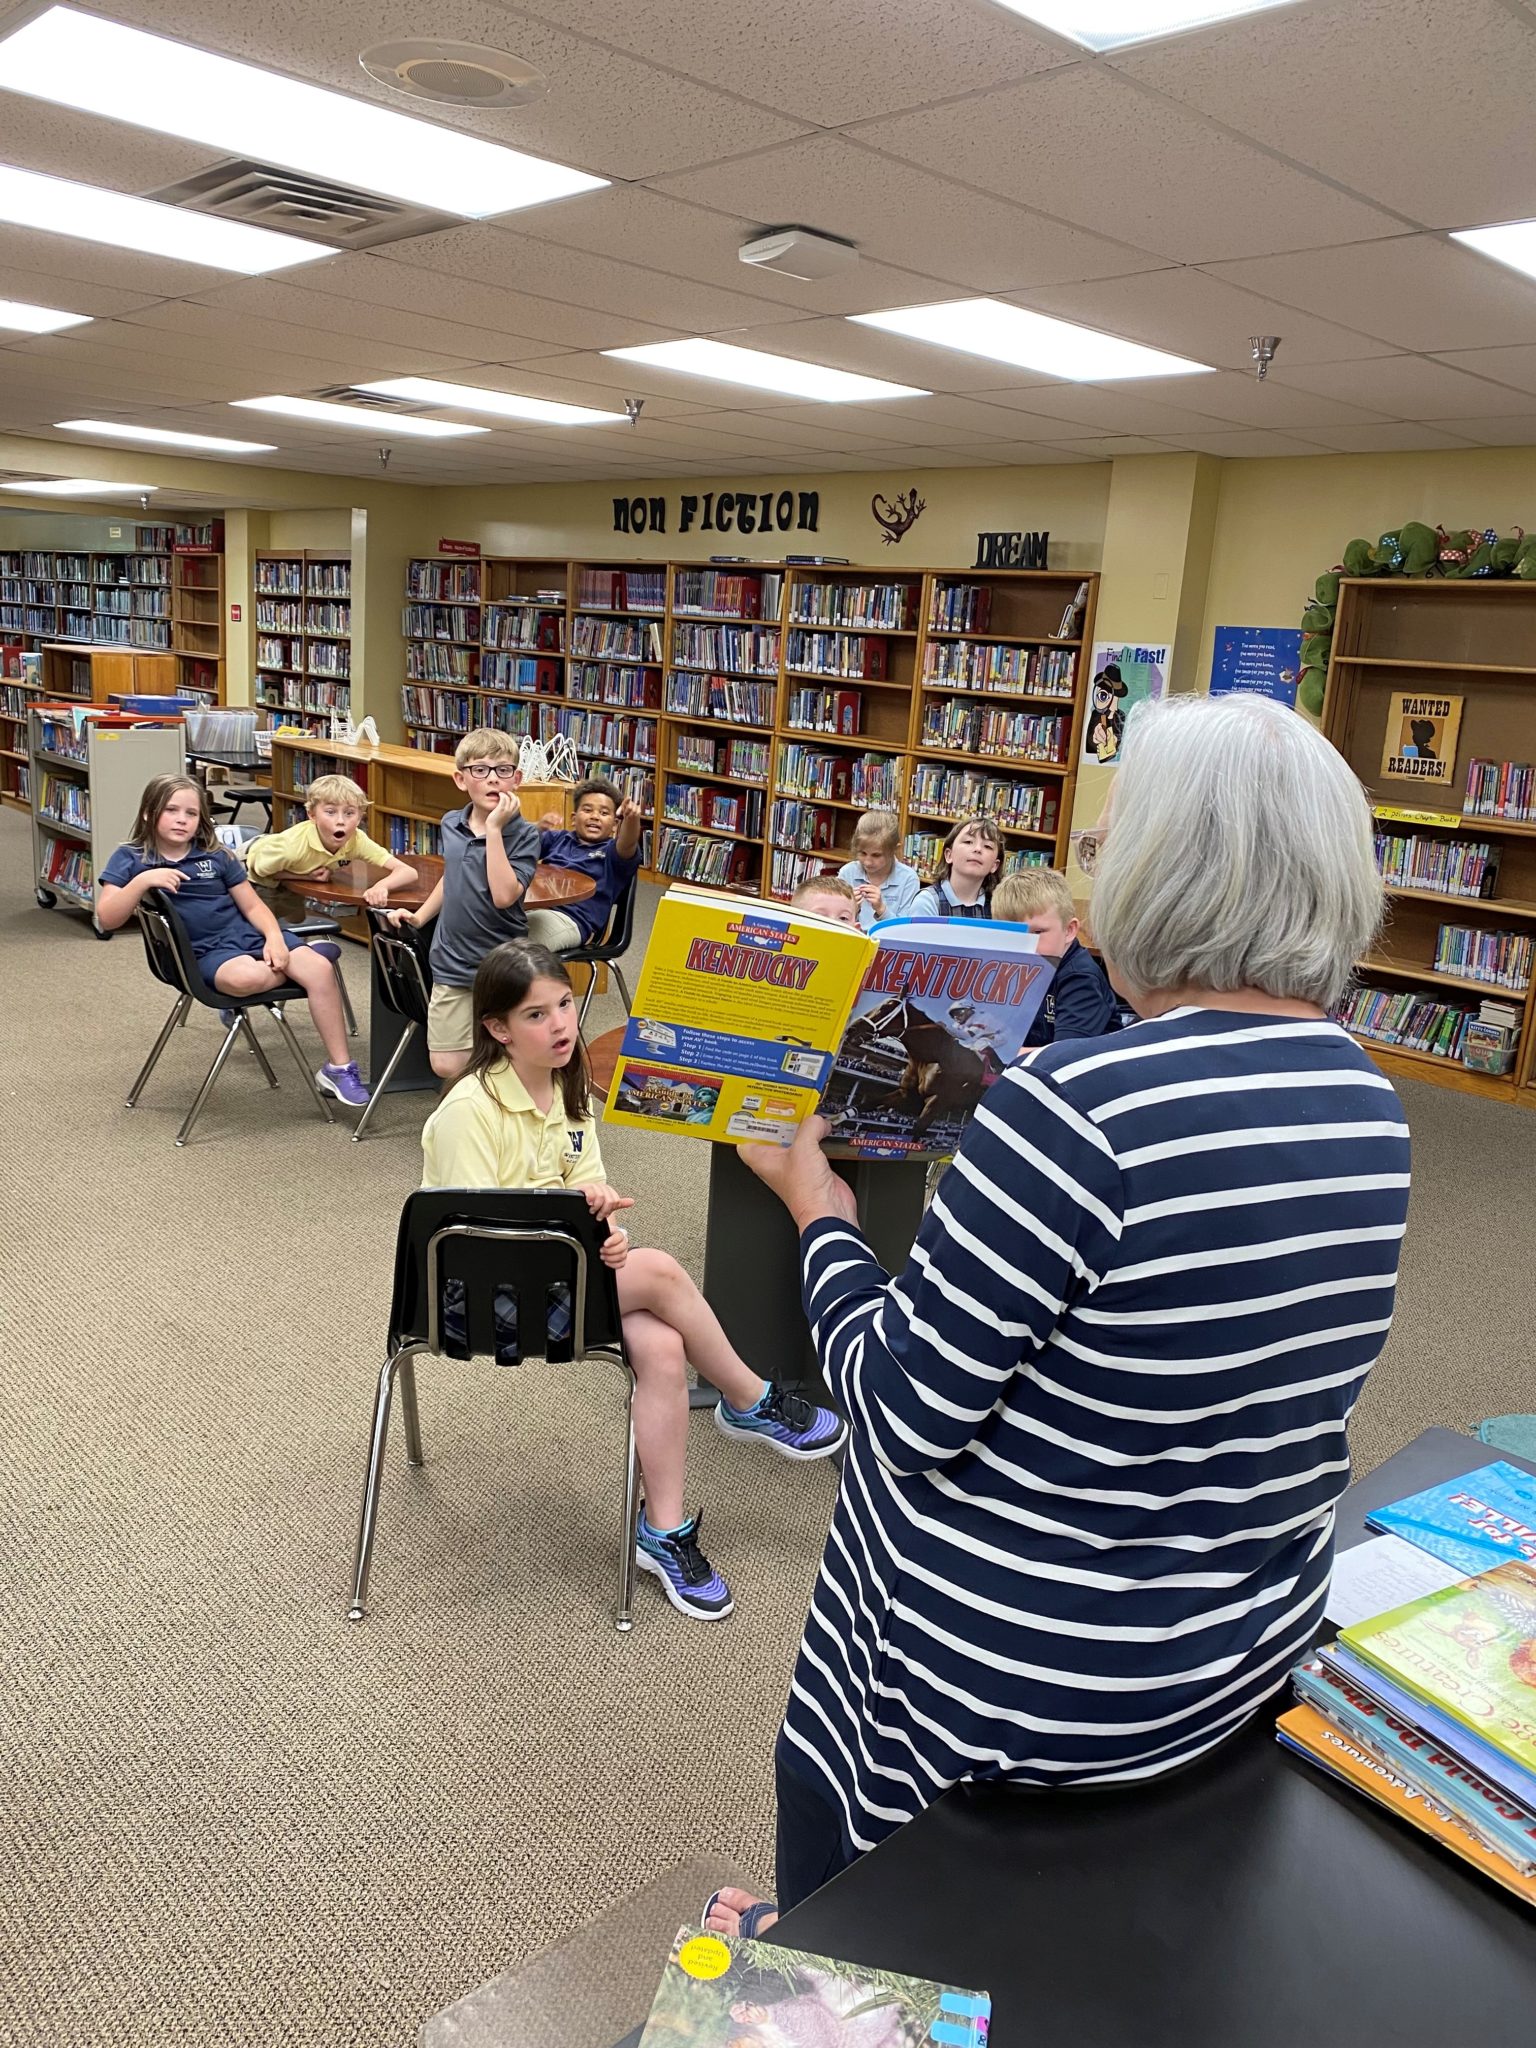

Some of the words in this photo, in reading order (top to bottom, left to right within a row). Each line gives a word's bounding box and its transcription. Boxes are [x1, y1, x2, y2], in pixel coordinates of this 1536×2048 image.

[678, 489, 820, 535] FICTION
[976, 530, 1051, 568] DREAM
[1106, 647, 1124, 662] Find
[1125, 648, 1132, 663] It
[1134, 647, 1166, 664] Fast!
[1402, 698, 1451, 717] WANTED
[1387, 757, 1447, 778] READERS!
[1379, 808, 1387, 817] 2
[728, 923, 769, 938] AMERICAN
[769, 930, 797, 943] STATES
[685, 937, 819, 991] KENTUCKY
[862, 947, 1043, 1007] KENTUCKY
[682, 1028, 701, 1037] Follow
[680, 1049, 695, 1057] Step
[683, 1041, 697, 1050] Step
[679, 1055, 693, 1064] Step
[567, 1130, 584, 1153] W
[849, 1138, 892, 1147] AMERICAN
[893, 1141, 922, 1150] STATES
[1466, 1519, 1514, 1544] for
[1371, 1630, 1496, 1718] Creatures
[1320, 1730, 1422, 1799] Adventures
[690, 1945, 724, 1958] Updated
[697, 1953, 713, 1962] and
[687, 1959, 718, 1973] Revised
